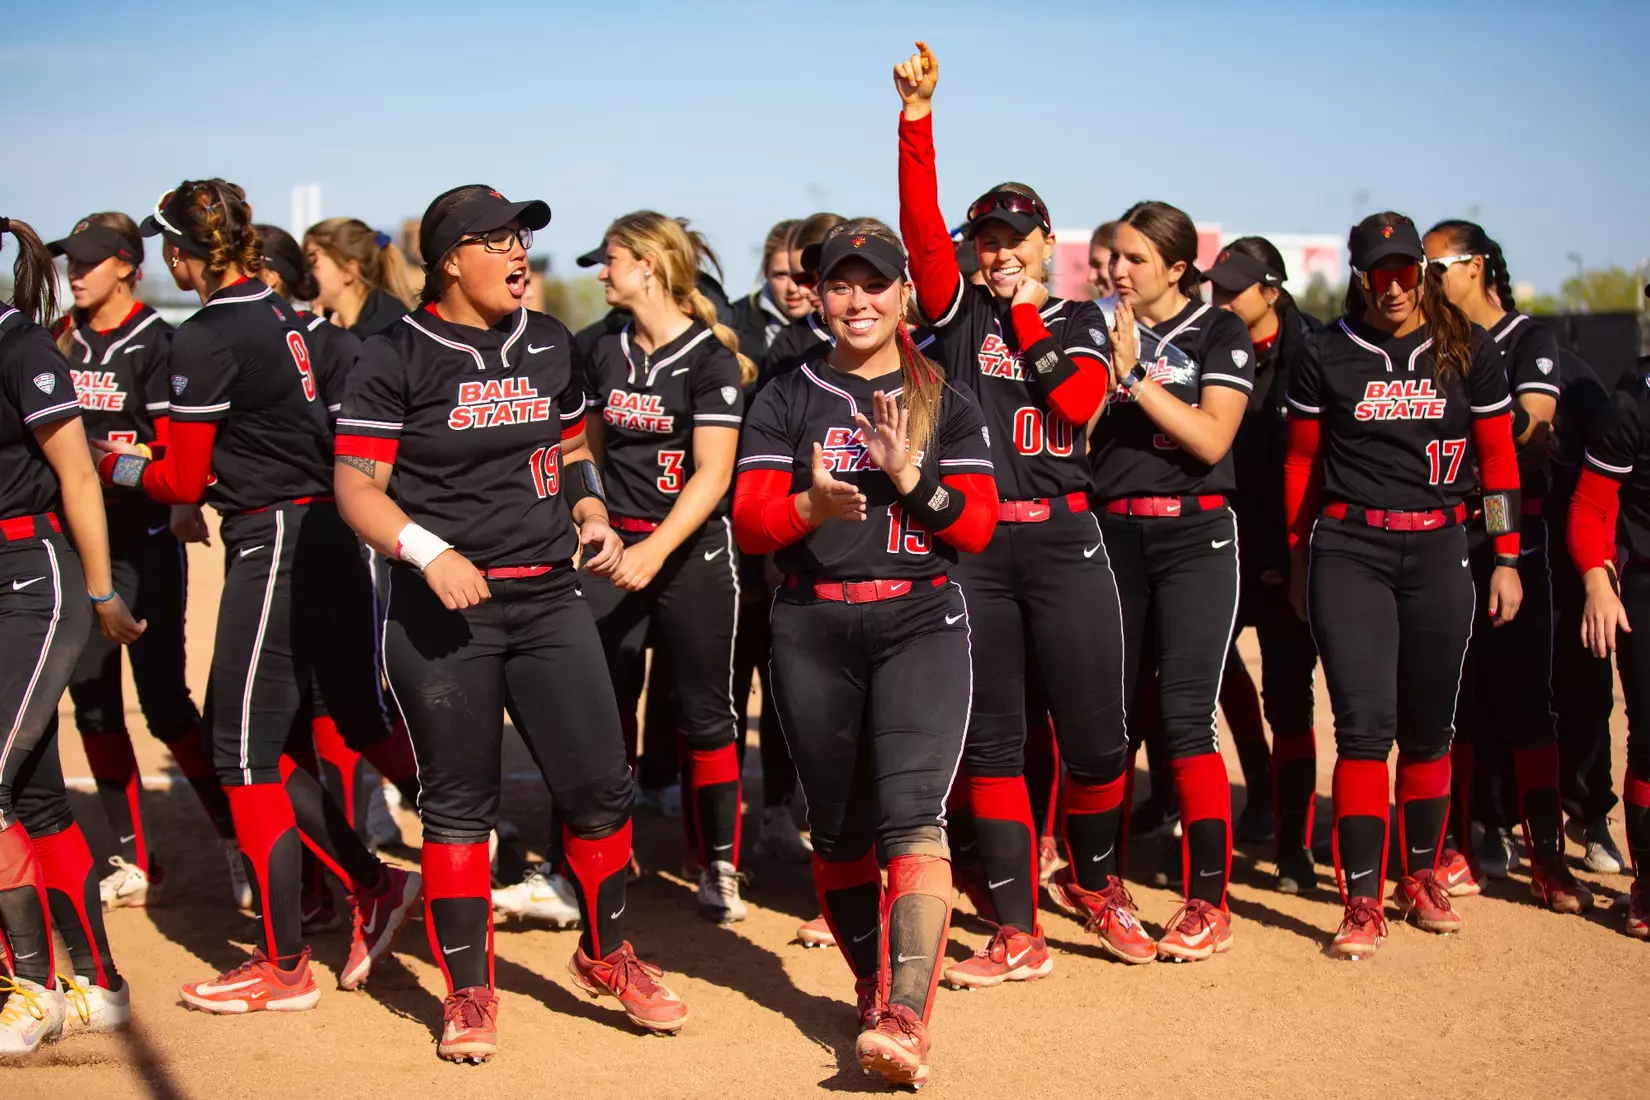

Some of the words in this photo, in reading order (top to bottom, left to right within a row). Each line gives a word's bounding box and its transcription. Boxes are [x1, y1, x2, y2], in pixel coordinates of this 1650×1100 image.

[980, 333, 1024, 360] BA
[286, 330, 316, 402] 9
[76, 390, 127, 412] ATE
[458, 376, 539, 406] BALL
[607, 388, 665, 416] BALL
[1363, 378, 1438, 401] BALL
[447, 396, 551, 431] STATE
[603, 406, 675, 434] STATE
[1354, 398, 1447, 421] STATE
[1012, 406, 1074, 457] 00
[528, 443, 561, 499] 19
[656, 449, 685, 494] 3
[822, 449, 925, 473] STAE
[1425, 437, 1467, 485] 17
[886, 501, 933, 555] 15
